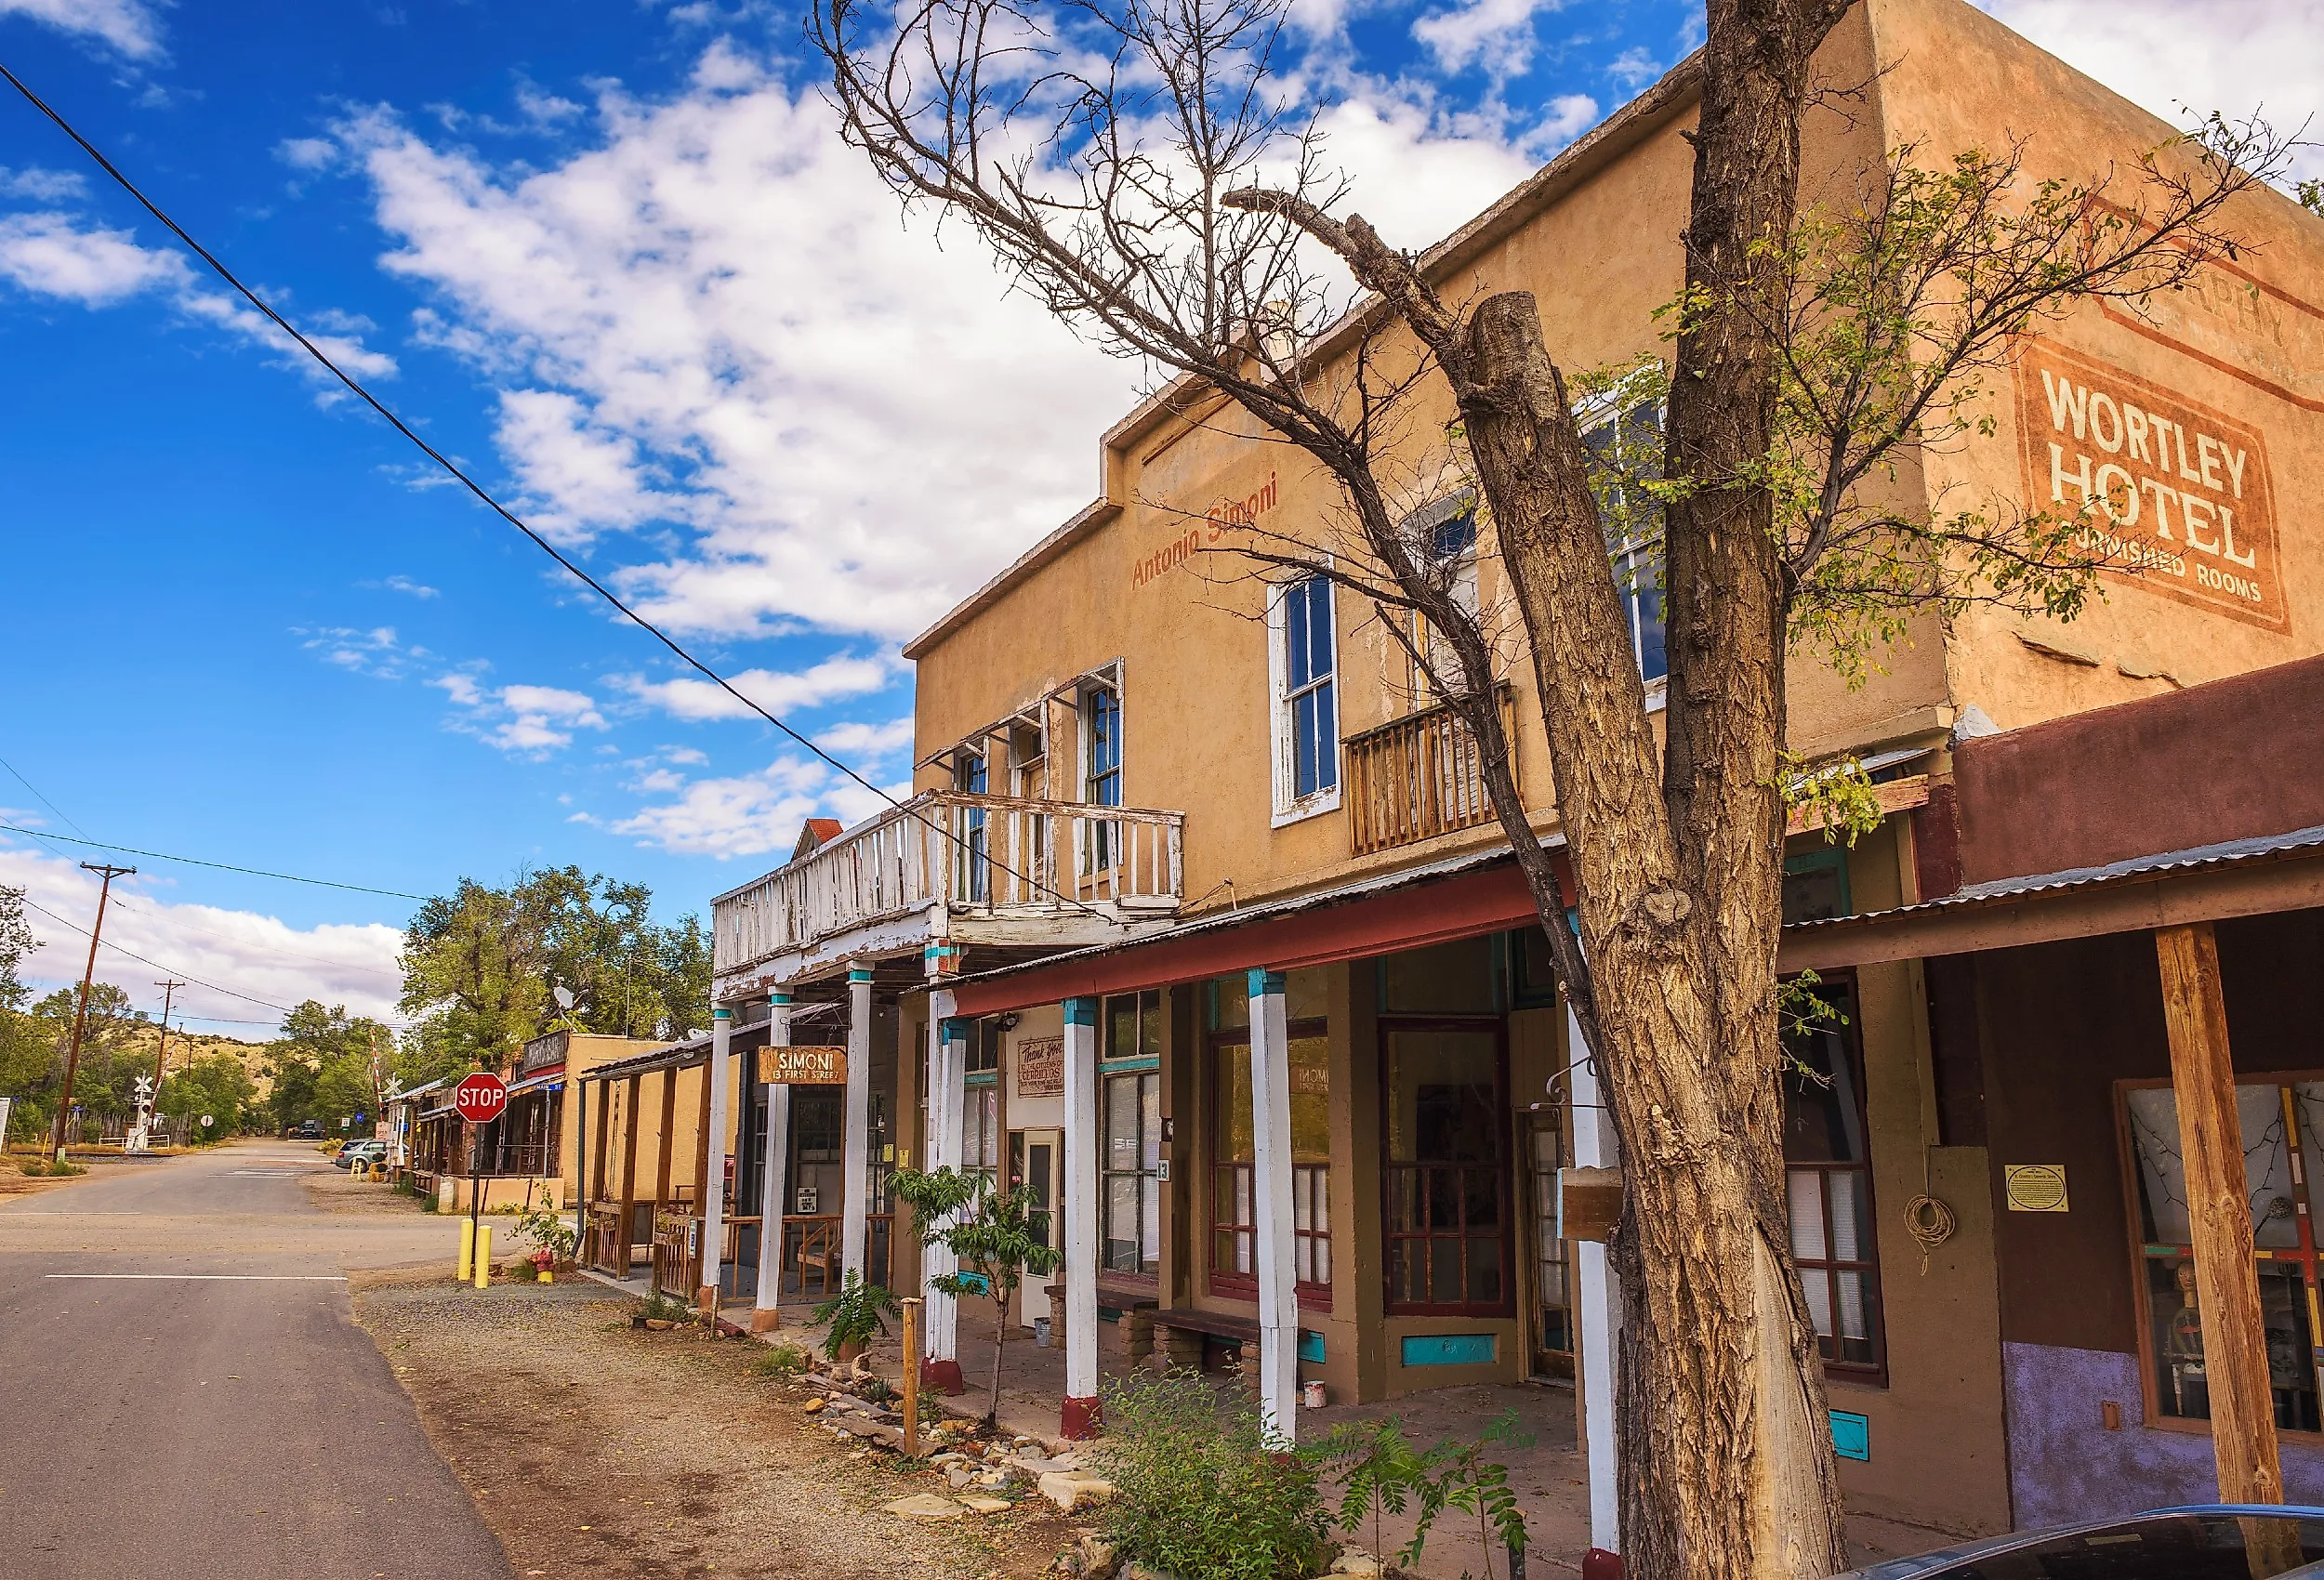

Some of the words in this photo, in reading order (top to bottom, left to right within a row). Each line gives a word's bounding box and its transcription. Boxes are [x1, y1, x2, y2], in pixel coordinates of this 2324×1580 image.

[2040, 368, 2247, 500] WORTLEY
[2048, 441, 2255, 569] HOTEL
[1131, 529, 1200, 591] Antonio
[1206, 471, 1277, 544] Simoni
[2197, 563, 2262, 603] ROOMS
[778, 1052, 834, 1070] SIMONI
[785, 1070, 808, 1079] FIRST
[1023, 1068, 1060, 1080] CERRILLOS
[458, 1087, 504, 1107] STOP
[1157, 1162, 1168, 1178] 13
